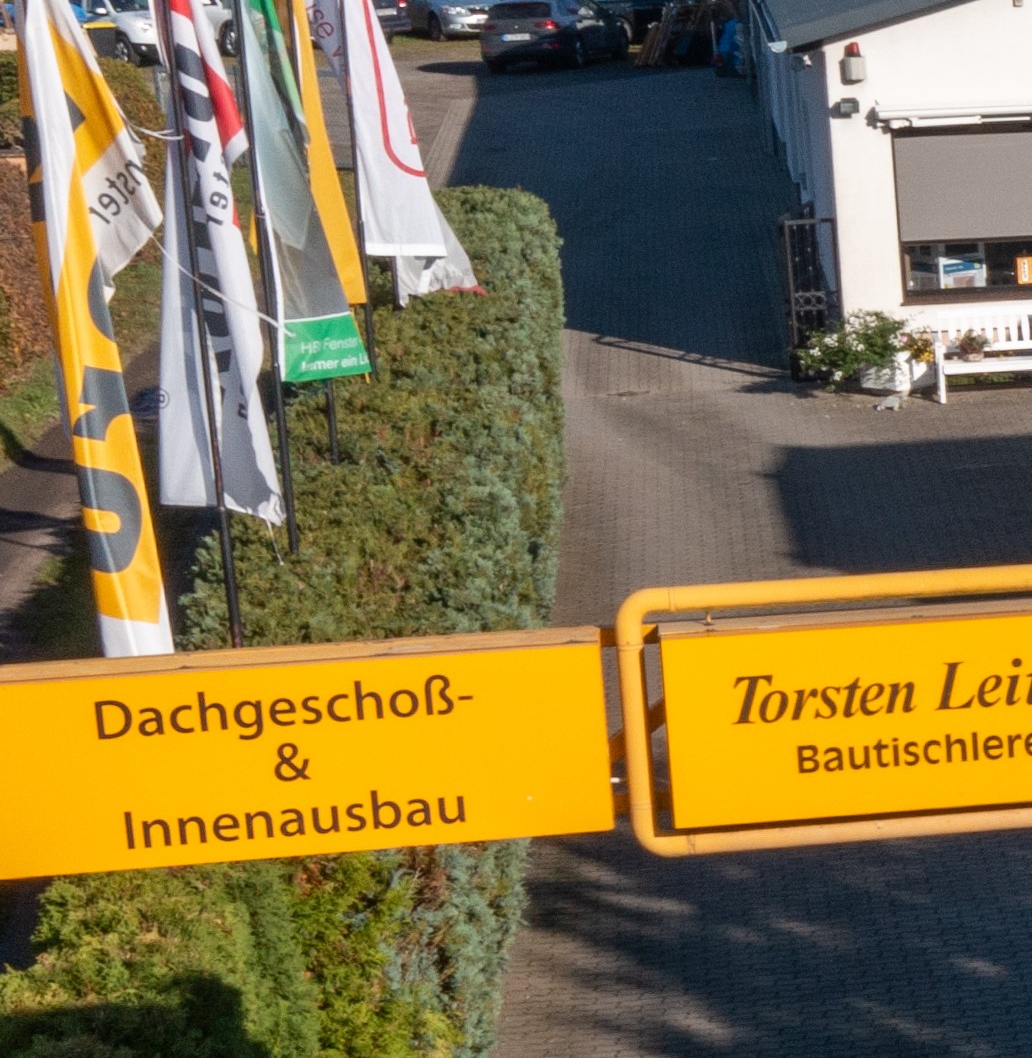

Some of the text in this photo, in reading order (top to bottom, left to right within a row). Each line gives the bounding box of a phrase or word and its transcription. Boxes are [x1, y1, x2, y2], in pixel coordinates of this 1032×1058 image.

[94, 673, 474, 741] Dachgeschoß-
[732, 673, 917, 725] Torsten
[274, 742, 311, 782] &
[124, 789, 467, 850] Innenausbau
